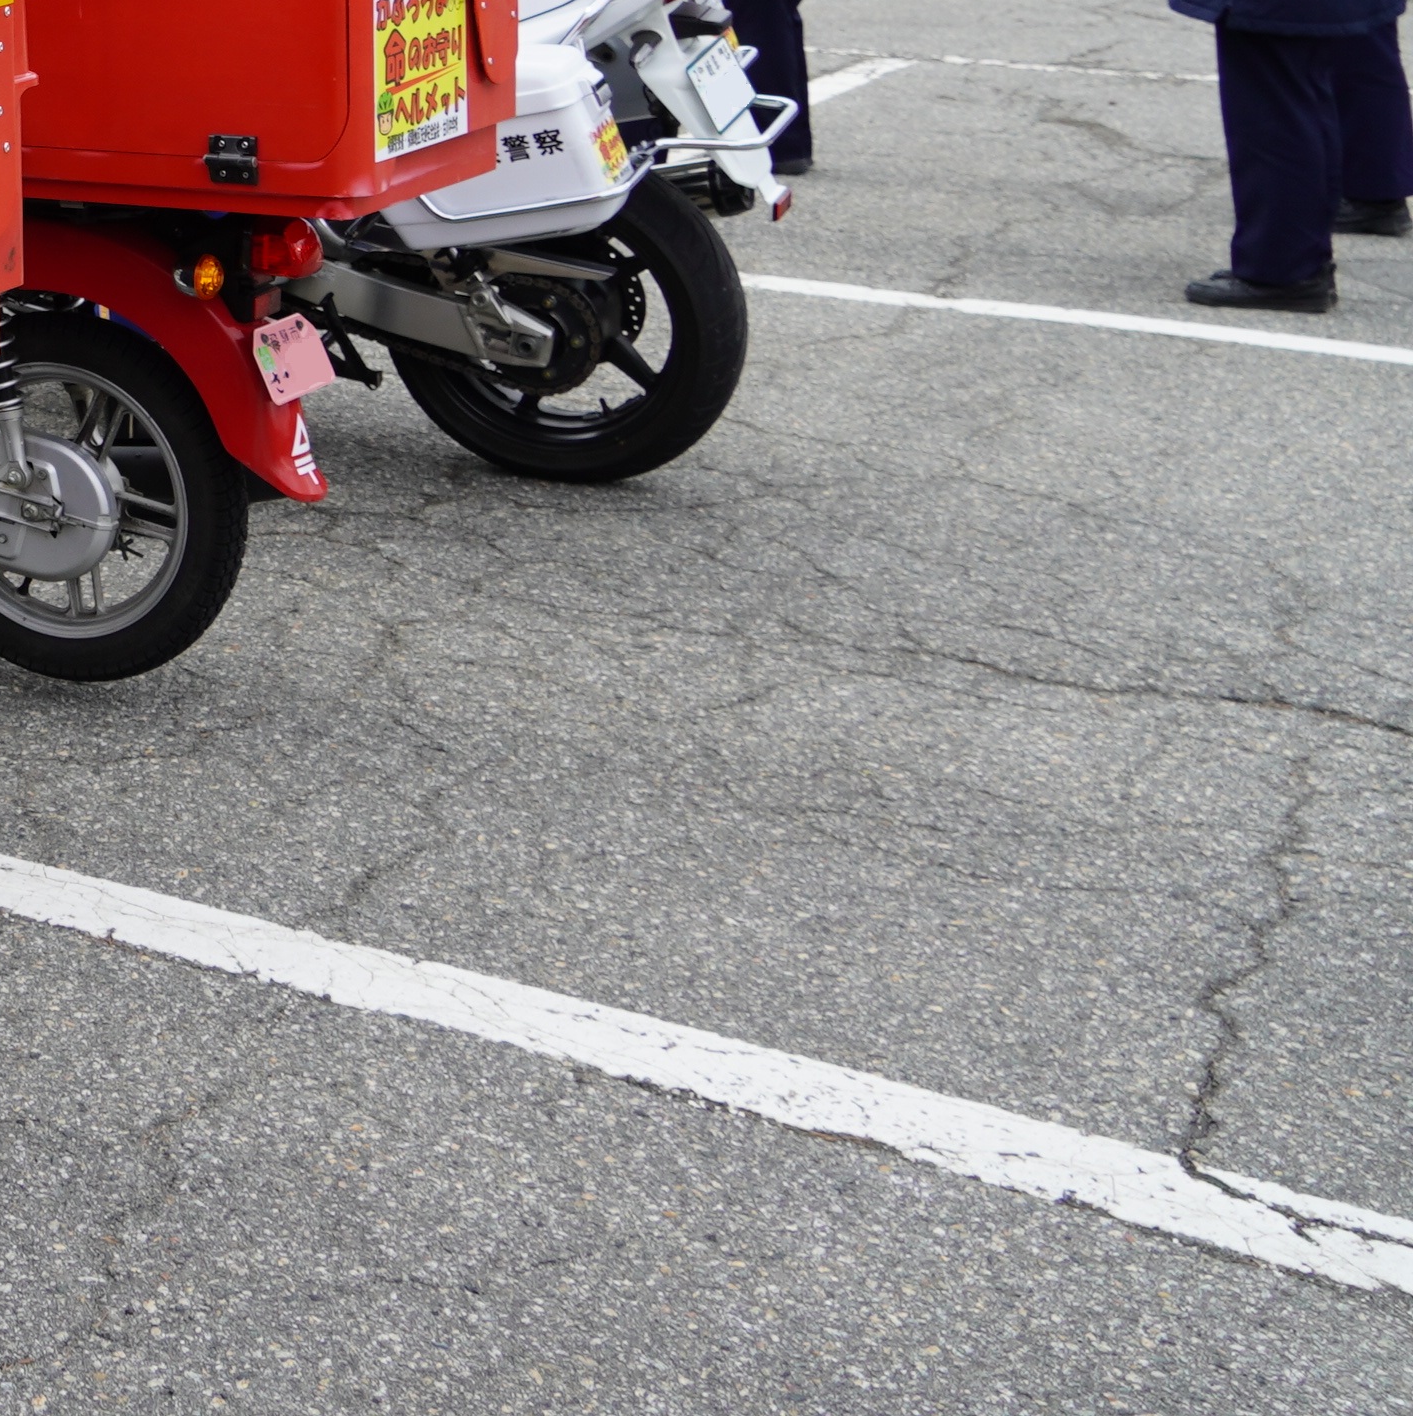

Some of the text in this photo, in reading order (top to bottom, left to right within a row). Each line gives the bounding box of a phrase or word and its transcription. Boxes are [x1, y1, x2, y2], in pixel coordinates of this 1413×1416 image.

[384, 25, 462, 86] 命のお守り
[394, 77, 466, 126] ヘルメット
[496, 129, 564, 163] 警察
